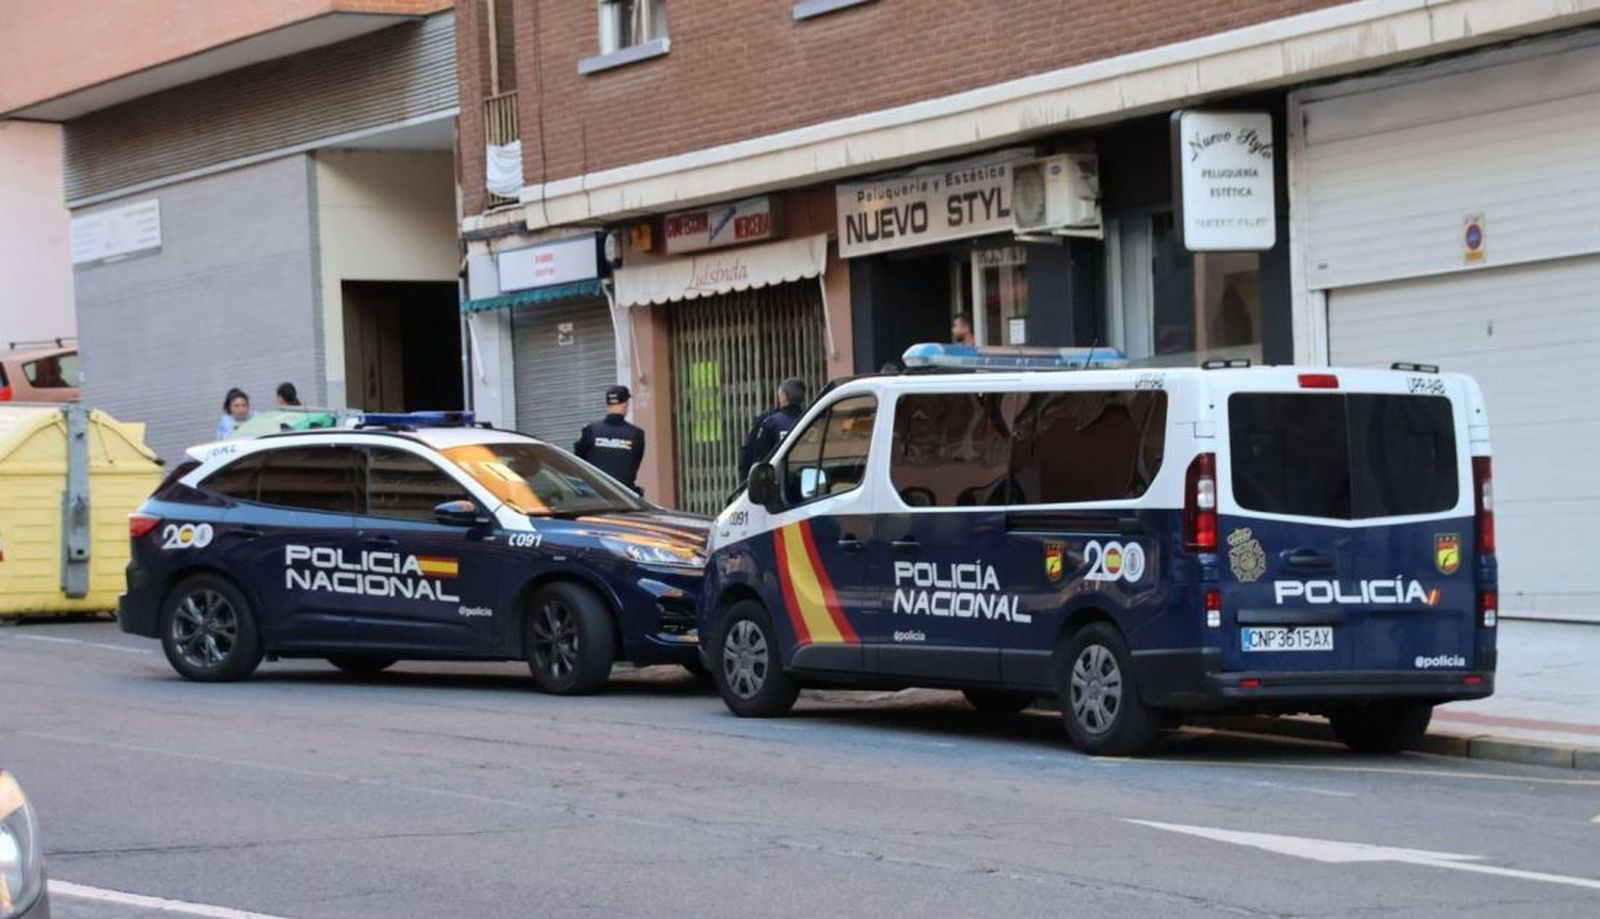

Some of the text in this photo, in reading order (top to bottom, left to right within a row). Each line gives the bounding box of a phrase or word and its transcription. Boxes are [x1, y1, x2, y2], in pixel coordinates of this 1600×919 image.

[1188, 131, 1231, 162] Nuevo
[933, 179, 940, 192] y
[846, 187, 1010, 245] NUEVO STYL
[162, 522, 214, 551] 200
[894, 559, 1001, 591] POLICÍA
[1083, 540, 1146, 583] 200
[285, 569, 460, 603] NACIONAL
[1274, 575, 1428, 605] POLICÍA
[893, 588, 1032, 623] NACIONAL
[1249, 629, 1330, 648] CNP3615AX
[1414, 654, 1466, 669] @policia
